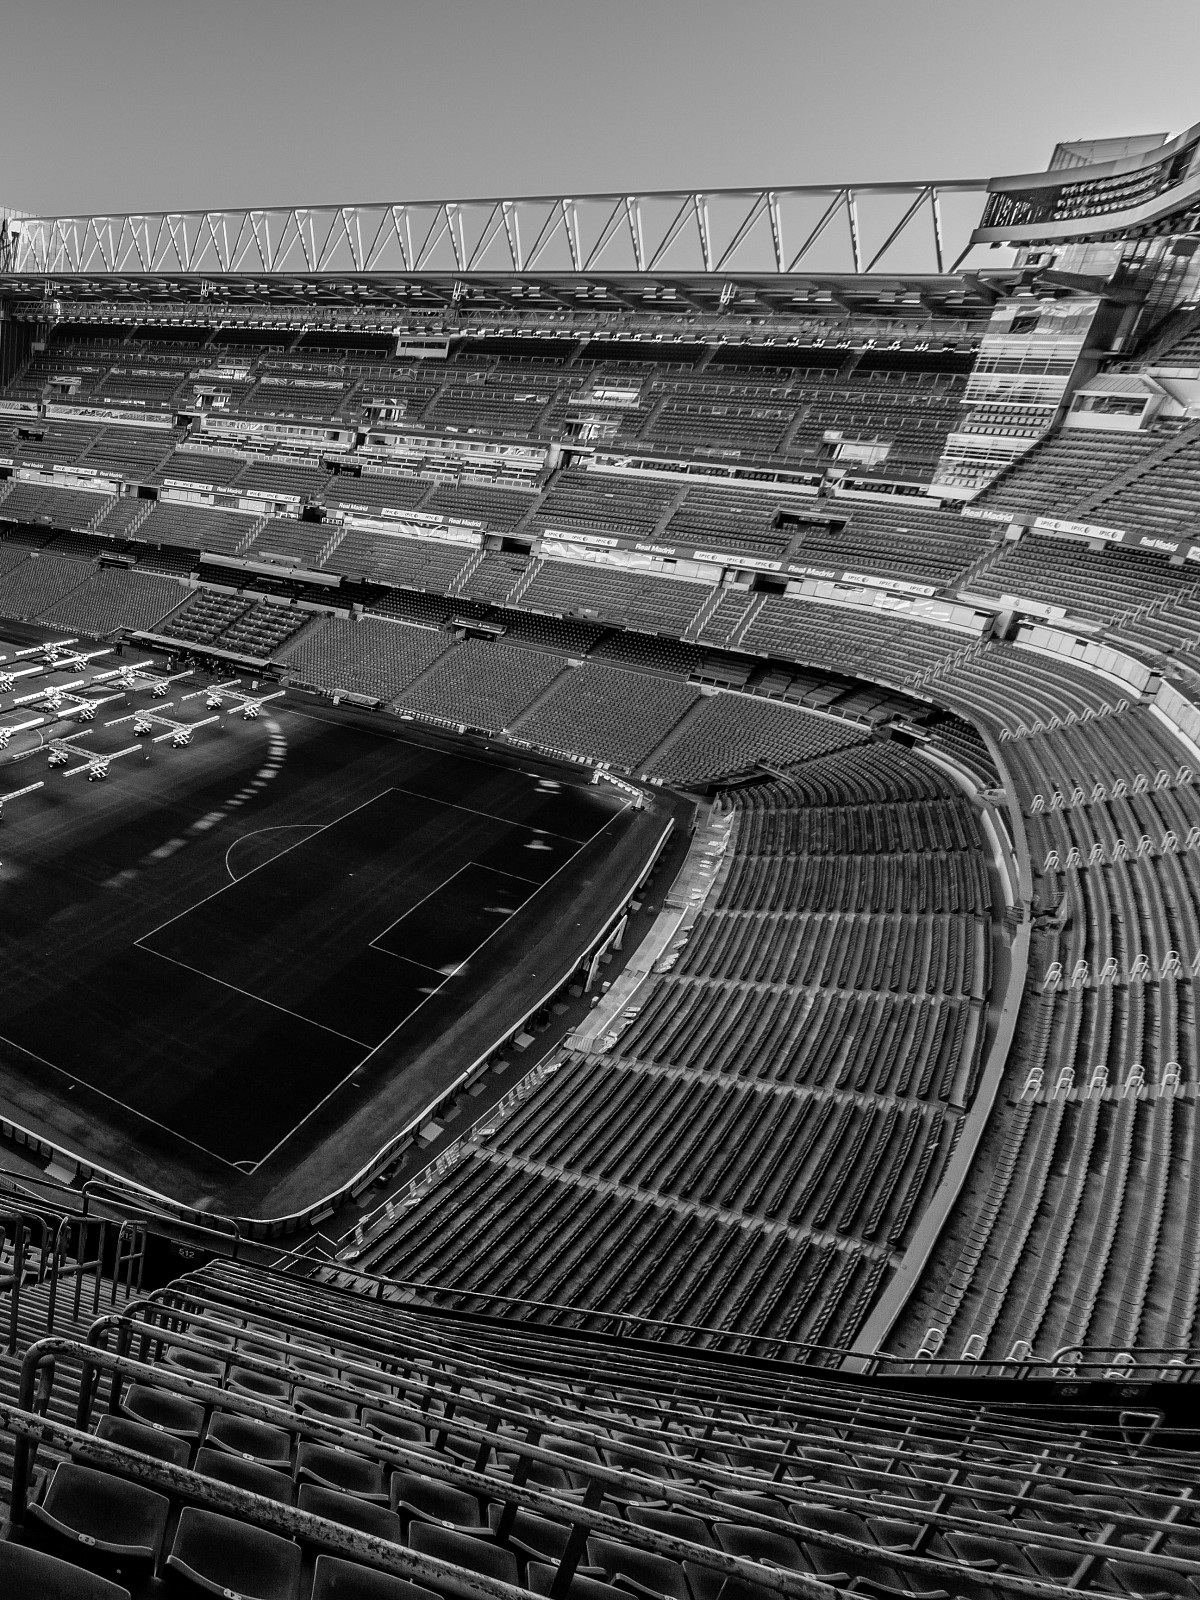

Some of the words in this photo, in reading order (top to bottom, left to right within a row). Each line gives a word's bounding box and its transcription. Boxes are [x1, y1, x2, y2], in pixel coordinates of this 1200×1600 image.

[961, 508, 982, 518] Real
[982, 511, 1014, 522] Madrid
[461, 519, 482, 527] Madrid
[635, 543, 651, 551] Real
[651, 545, 676, 554] Madrid
[788, 565, 806, 573] Real
[807, 568, 835, 578] Madrid
[179, 1248, 195, 1259] 512
